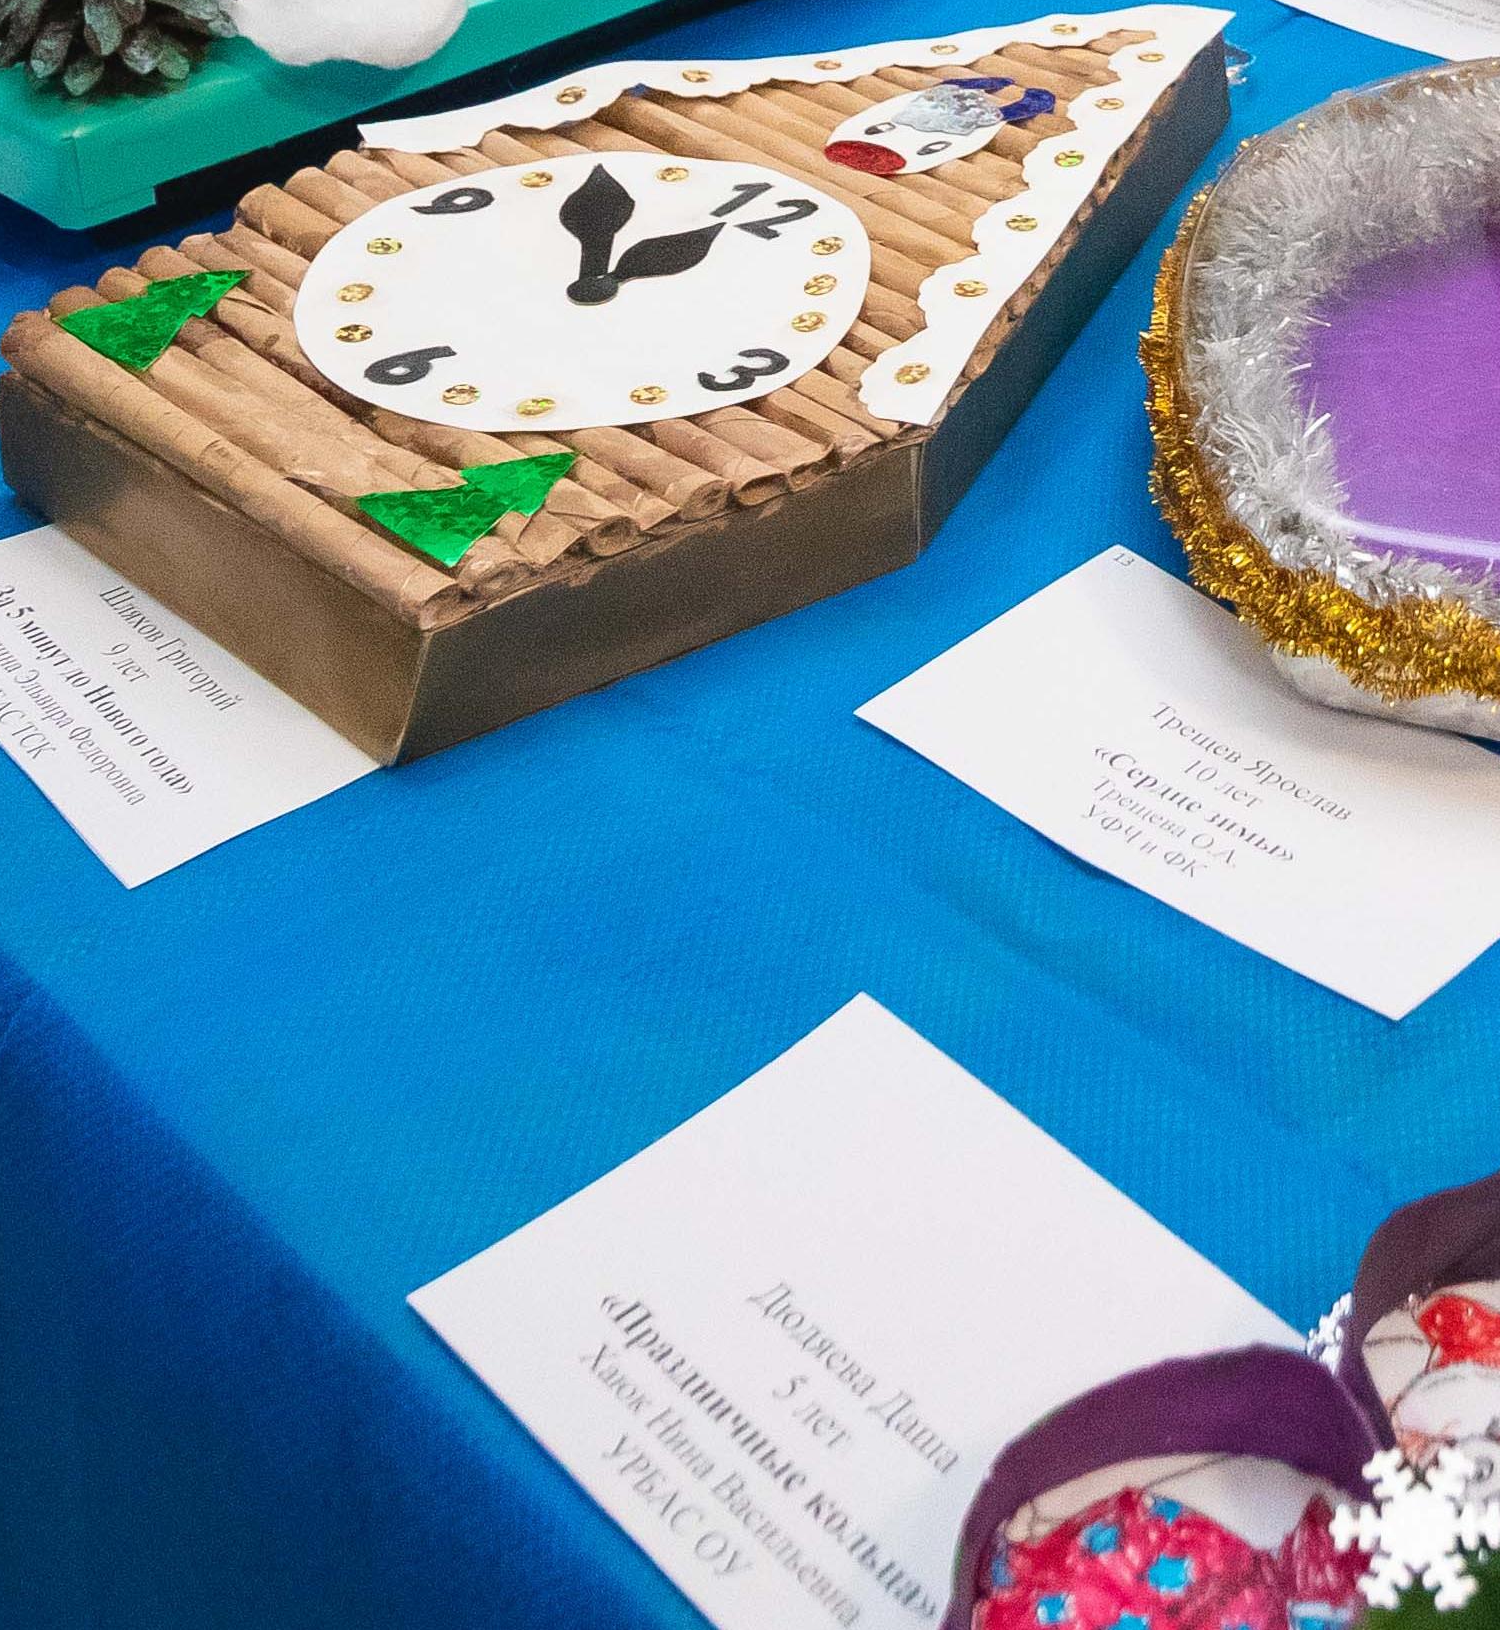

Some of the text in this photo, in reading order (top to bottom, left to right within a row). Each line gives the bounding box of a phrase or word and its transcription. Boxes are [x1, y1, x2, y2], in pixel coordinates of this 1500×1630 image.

[410, 187, 494, 216] 9
[708, 181, 820, 239] 12
[363, 345, 457, 385] 6
[697, 348, 790, 393] 3
[6, 606, 35, 620] 5
[18, 620, 77, 667] минут
[60, 667, 92, 688] до
[100, 585, 244, 712] Шляхов Григорий
[100, 643, 150, 684] 9 лет
[12, 720, 57, 760] ТСК
[14, 669, 75, 730] Эльвира
[69, 725, 147, 806] Федоровна
[84, 684, 149, 747] Нового
[140, 746, 195, 795] года»
[1150, 701, 1352, 821] Трещев Ярослав
[1183, 759, 1264, 809] 10 лет
[1093, 776, 1237, 868] Трещева О.А.
[1094, 747, 1295, 862] «Сердце зимы»
[1081, 803, 1209, 878] УФЧ и ФК
[747, 1281, 960, 1474] Дюдяева Даша
[771, 1373, 852, 1450] 5 лет
[599, 1294, 937, 1619] «Праздничные кольца»
[601, 1432, 754, 1578] УРБАС ОУ
[646, 1406, 715, 1482] Нина
[711, 1470, 861, 1628] Васильевна
